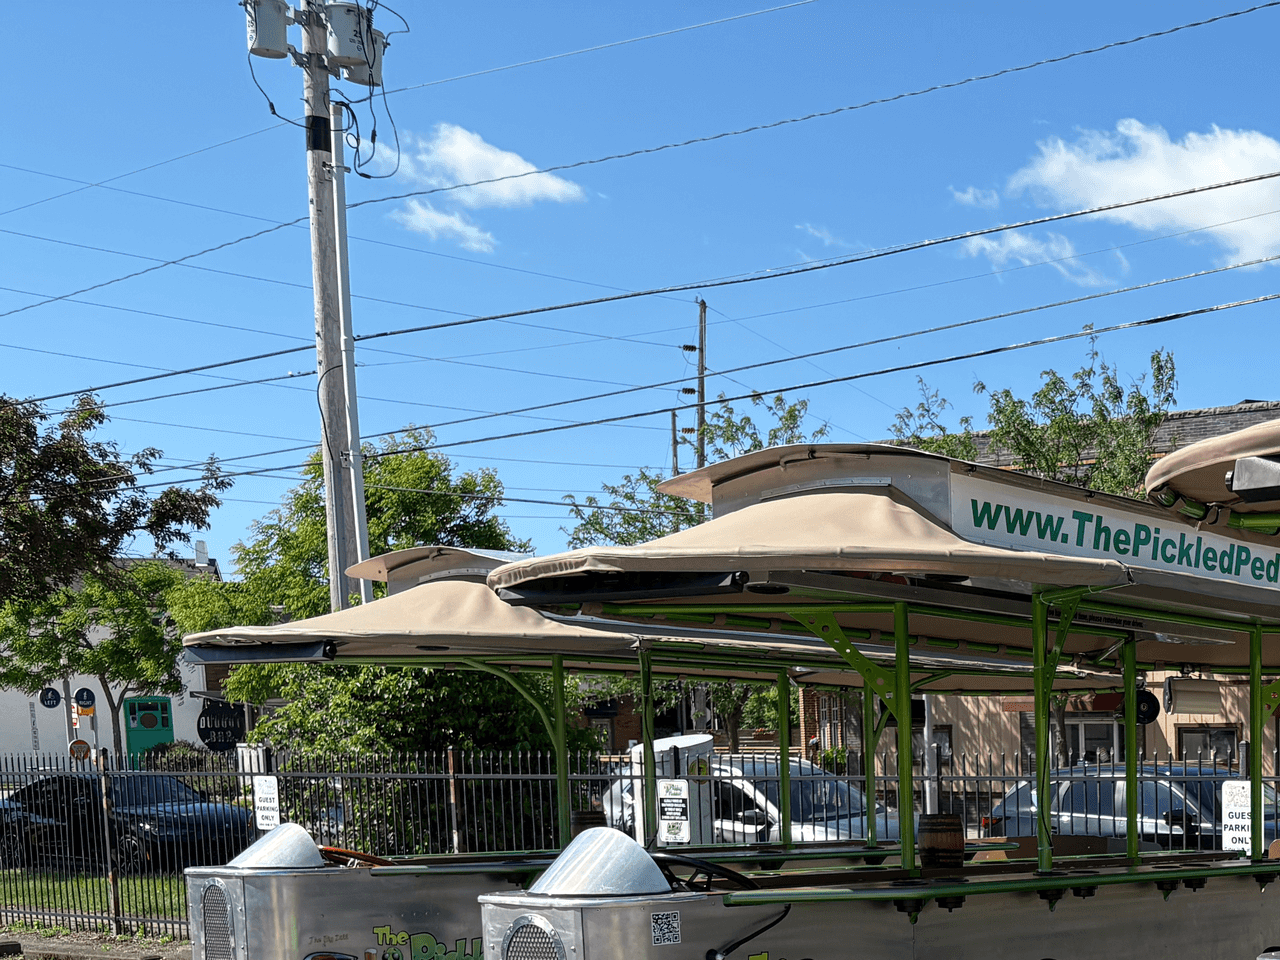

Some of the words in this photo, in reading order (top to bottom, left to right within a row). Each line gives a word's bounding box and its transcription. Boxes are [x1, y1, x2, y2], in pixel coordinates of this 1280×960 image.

[209, 730, 238, 743] BAR
[1228, 811, 1252, 820] GUES
[1223, 823, 1250, 832] PARKI
[373, 925, 409, 946] The
